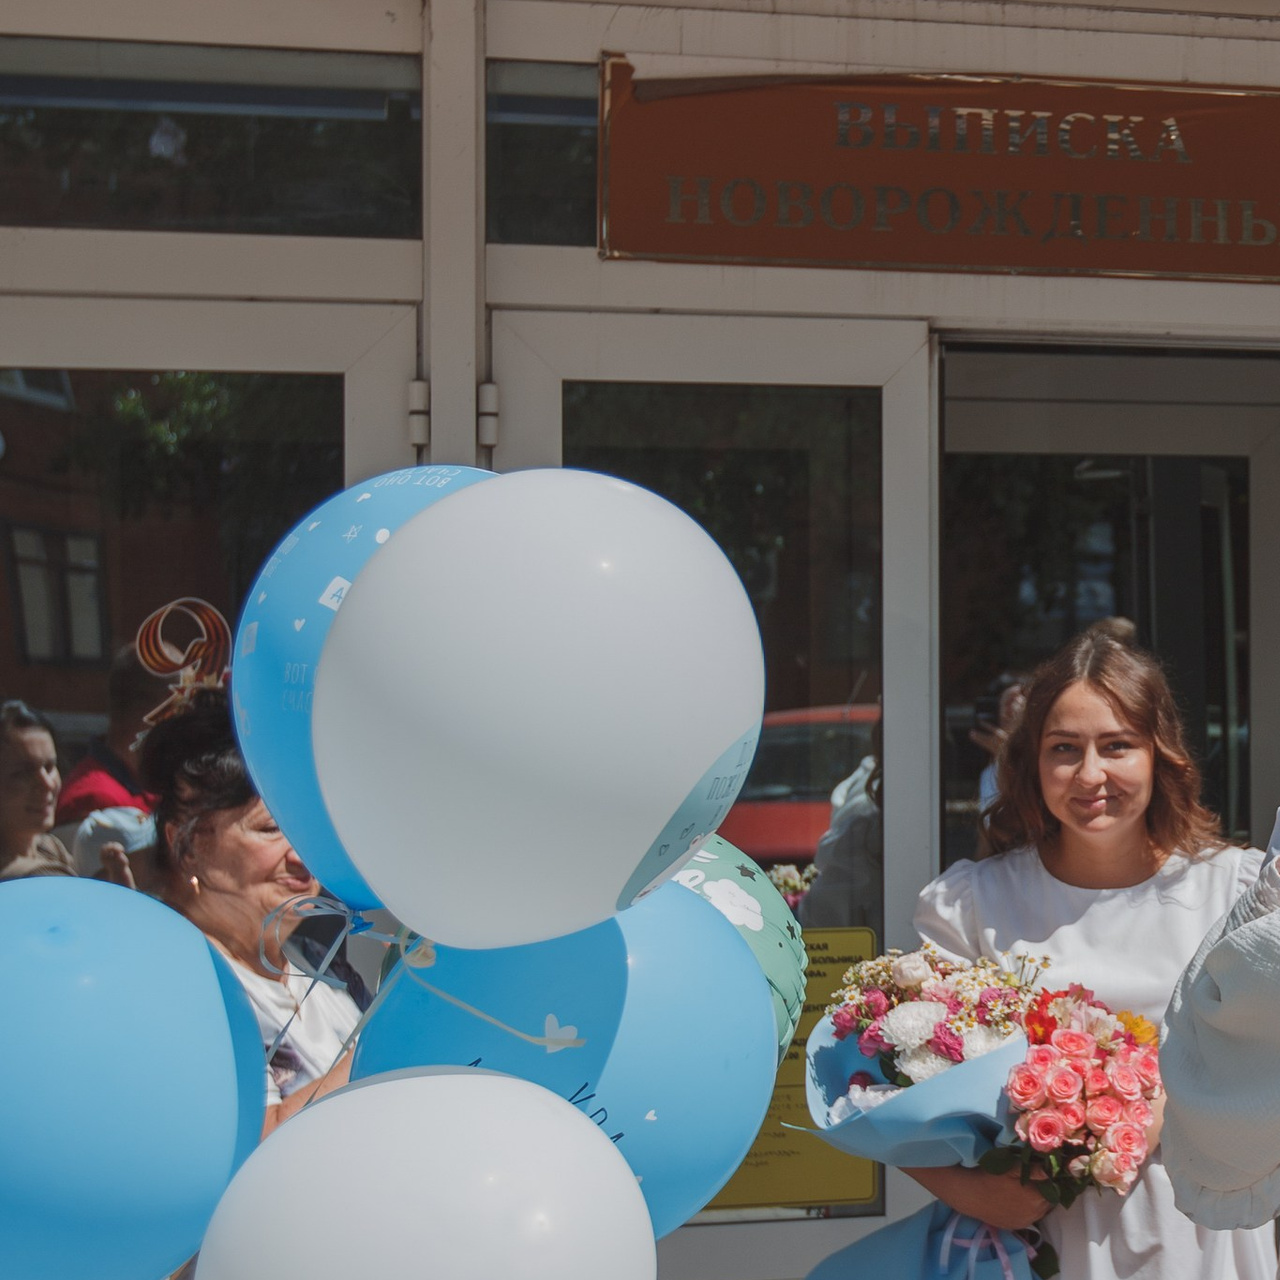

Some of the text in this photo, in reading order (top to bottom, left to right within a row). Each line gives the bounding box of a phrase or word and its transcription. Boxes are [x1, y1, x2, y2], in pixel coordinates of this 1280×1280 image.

[834, 101, 1193, 163] ВЫПИСКА
[413, 475, 452, 488] ВОТ
[282, 689, 313, 713] СЧАС
